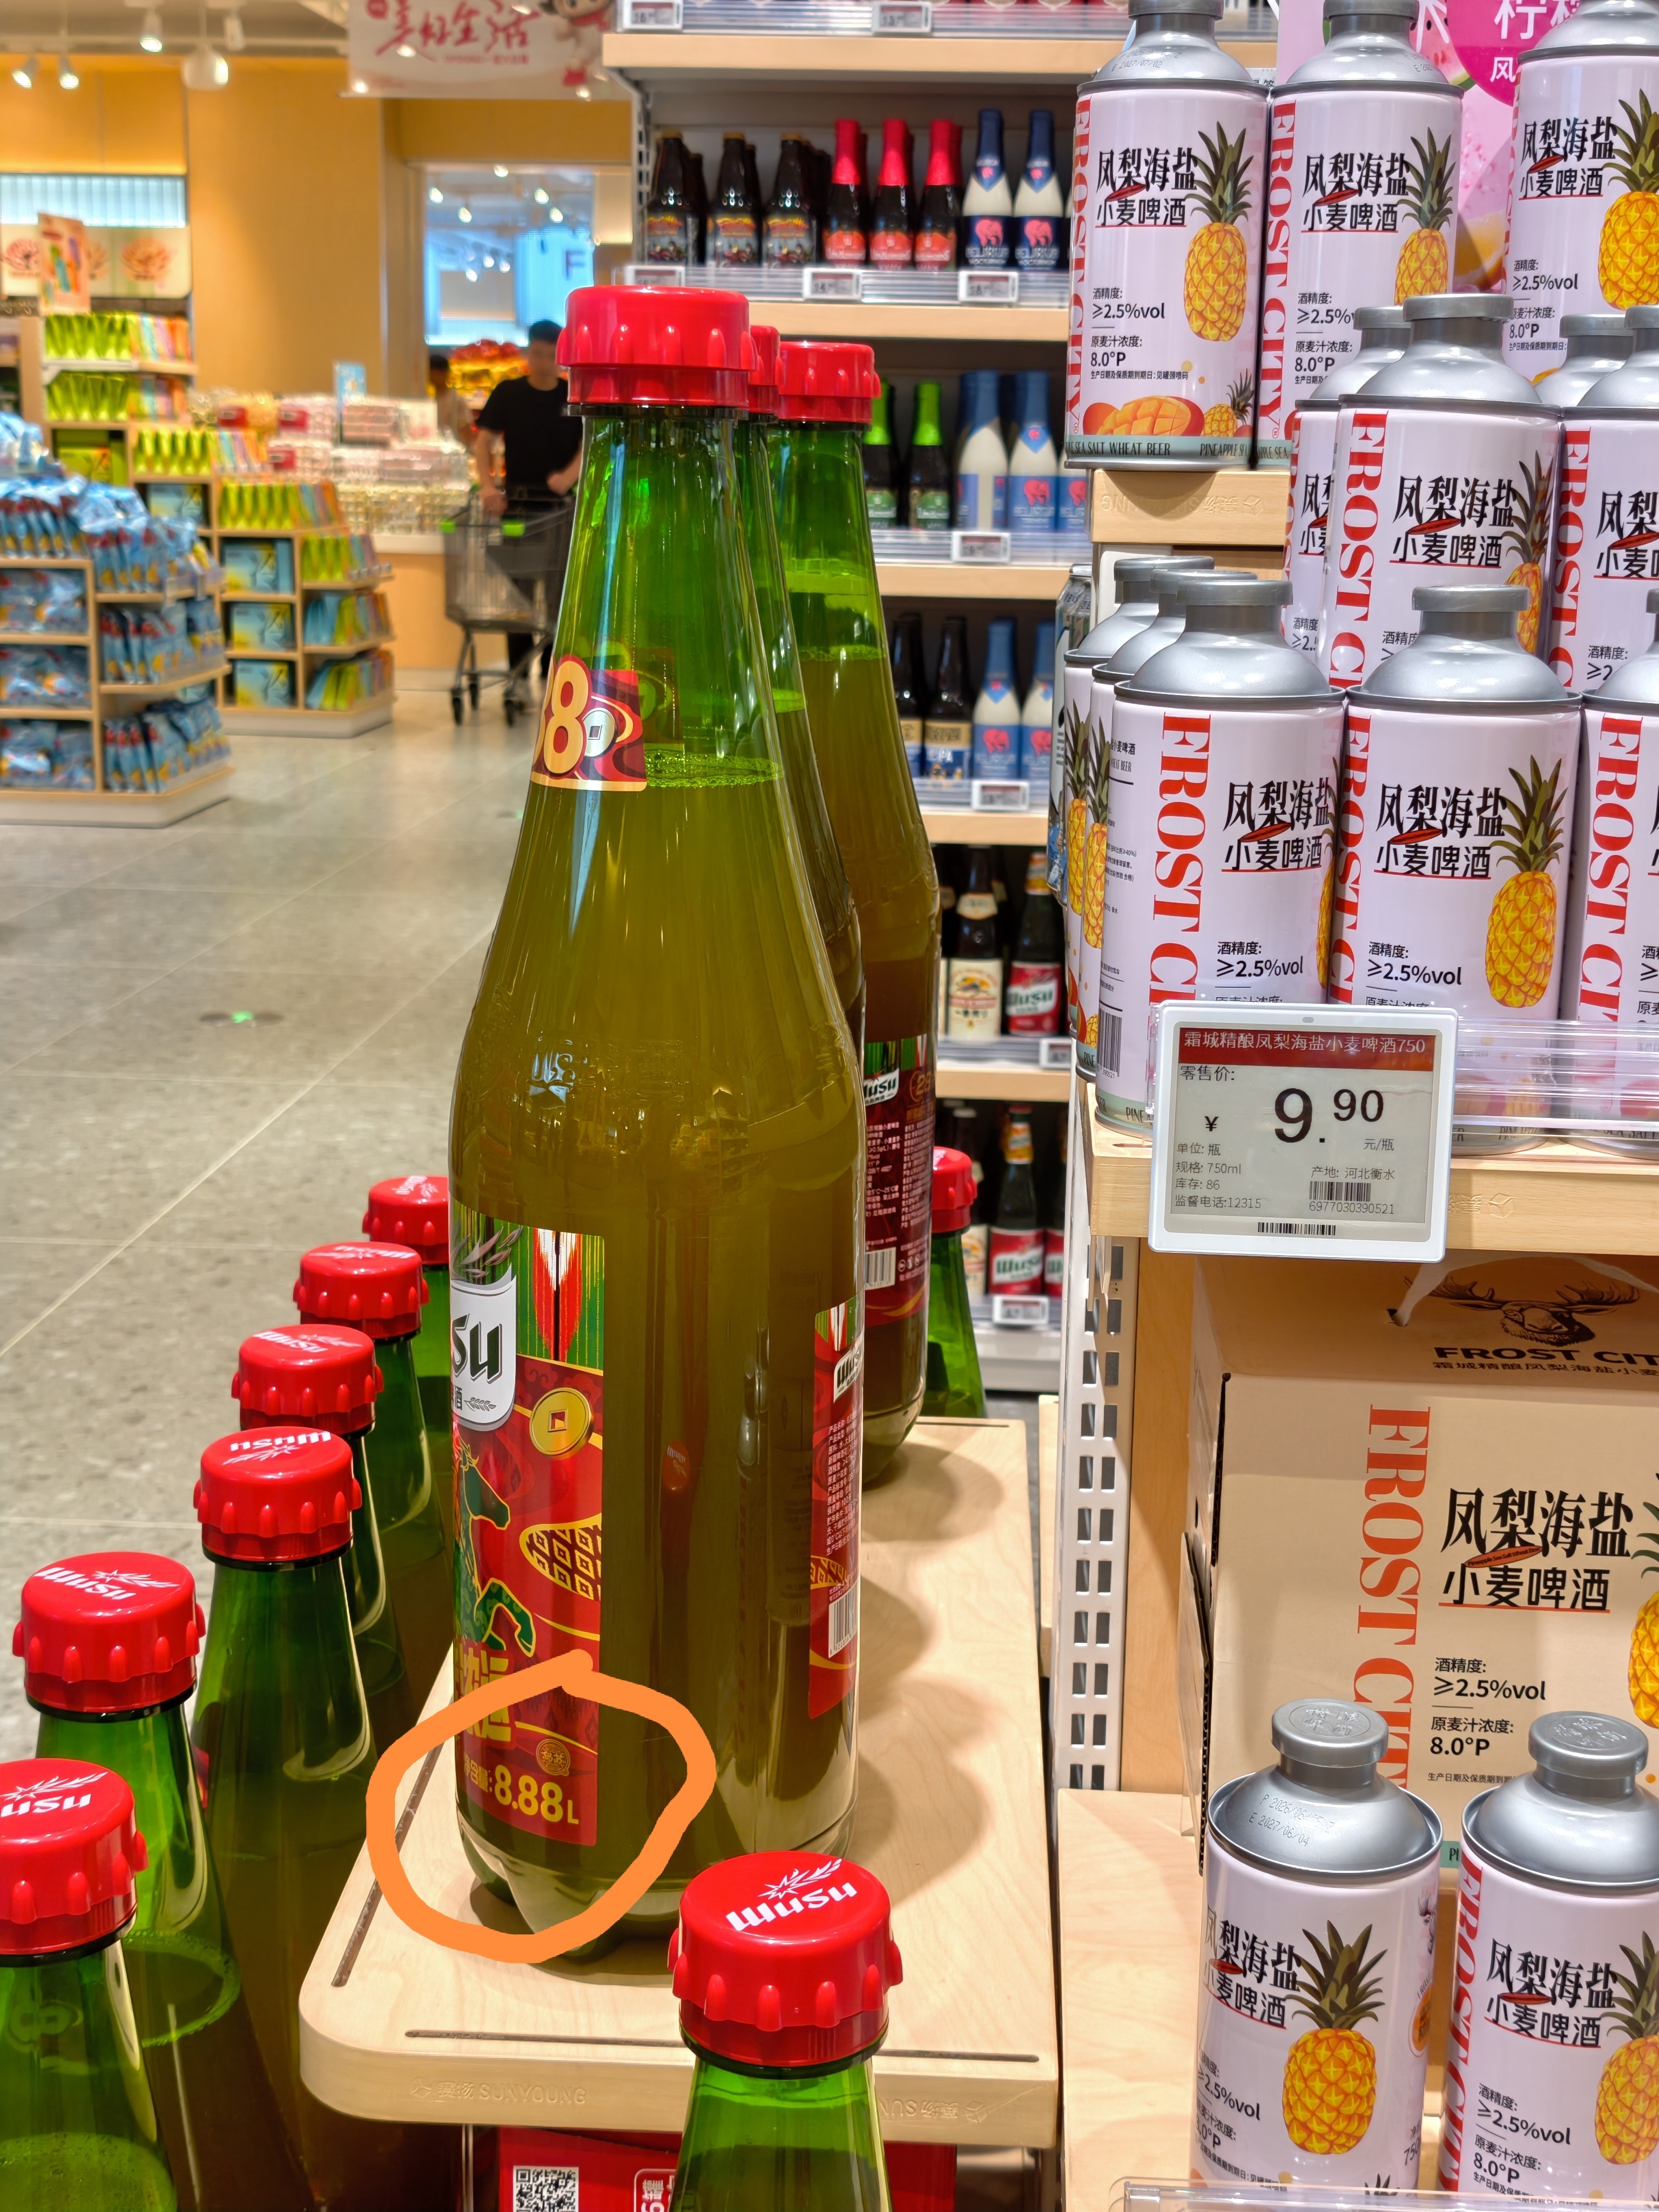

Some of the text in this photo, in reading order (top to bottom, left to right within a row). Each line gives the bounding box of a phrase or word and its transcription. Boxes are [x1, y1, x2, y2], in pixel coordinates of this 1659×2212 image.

[1520, 116, 1617, 166] 凤梨海盐
[1096, 146, 1199, 195] 凤梨海盐
[1265, 101, 1296, 287] FROST
[1302, 152, 1411, 198] 凤梨海盐
[1520, 168, 1603, 197] 小麦啤酒
[1097, 198, 1186, 227] 小麦啤酒
[1303, 202, 1398, 231] 小麦啤酒
[1109, 442, 1144, 456] WHEAT
[1146, 443, 1171, 456] BEER
[1335, 409, 1388, 622] FROST
[1393, 475, 1520, 528] 凤梨海盐
[1393, 532, 1503, 568] 小麦啤酒
[1552, 427, 1591, 637] FROST
[1153, 712, 1211, 933] FROST
[1223, 777, 1331, 832] 凤梨海盐
[1335, 714, 1372, 931] FROST
[1376, 784, 1508, 840] 凤梨海盐
[1586, 713, 1643, 935] FROST
[1225, 838, 1324, 871] 小麦啤酒
[1377, 844, 1492, 878] 小麦啤酒
[1184, 1030, 1426, 1053] 霜城精酿凤梨海盐小麦啤酒750
[1179, 1065, 1235, 1082] 零售价:
[1364, 1138, 1395, 1151] 元/瓶
[1309, 1201, 1395, 1215] 6977030390521
[1434, 1346, 1580, 1361] FROST
[1357, 1404, 1431, 1646] FROST
[1440, 1487, 1634, 1559] 凤梨海盐
[1443, 1563, 1610, 1610] 小麦啤酒
[1205, 1903, 1301, 1993] 凤梨海盐
[1204, 1960, 1286, 2028] 小麦啤酒
[1487, 1938, 1619, 2009] 凤梨海盐
[1487, 1995, 1602, 2047] 小麦啤酒
